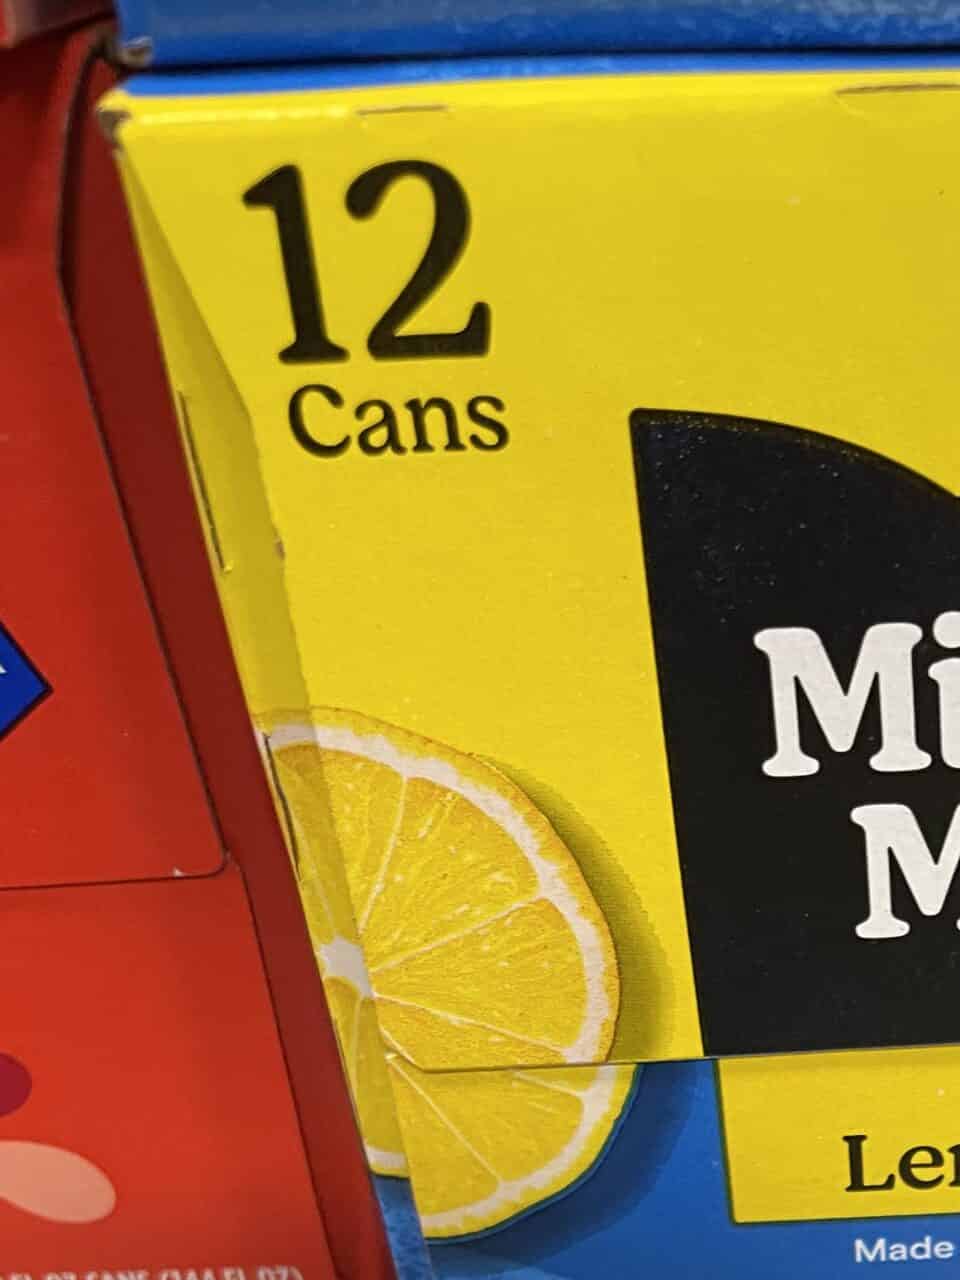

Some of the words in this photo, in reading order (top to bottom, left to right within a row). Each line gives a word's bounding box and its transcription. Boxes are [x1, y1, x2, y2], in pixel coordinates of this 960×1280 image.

[242, 159, 491, 364] 12
[288, 382, 510, 457] Cans
[854, 1236, 954, 1264] Made
